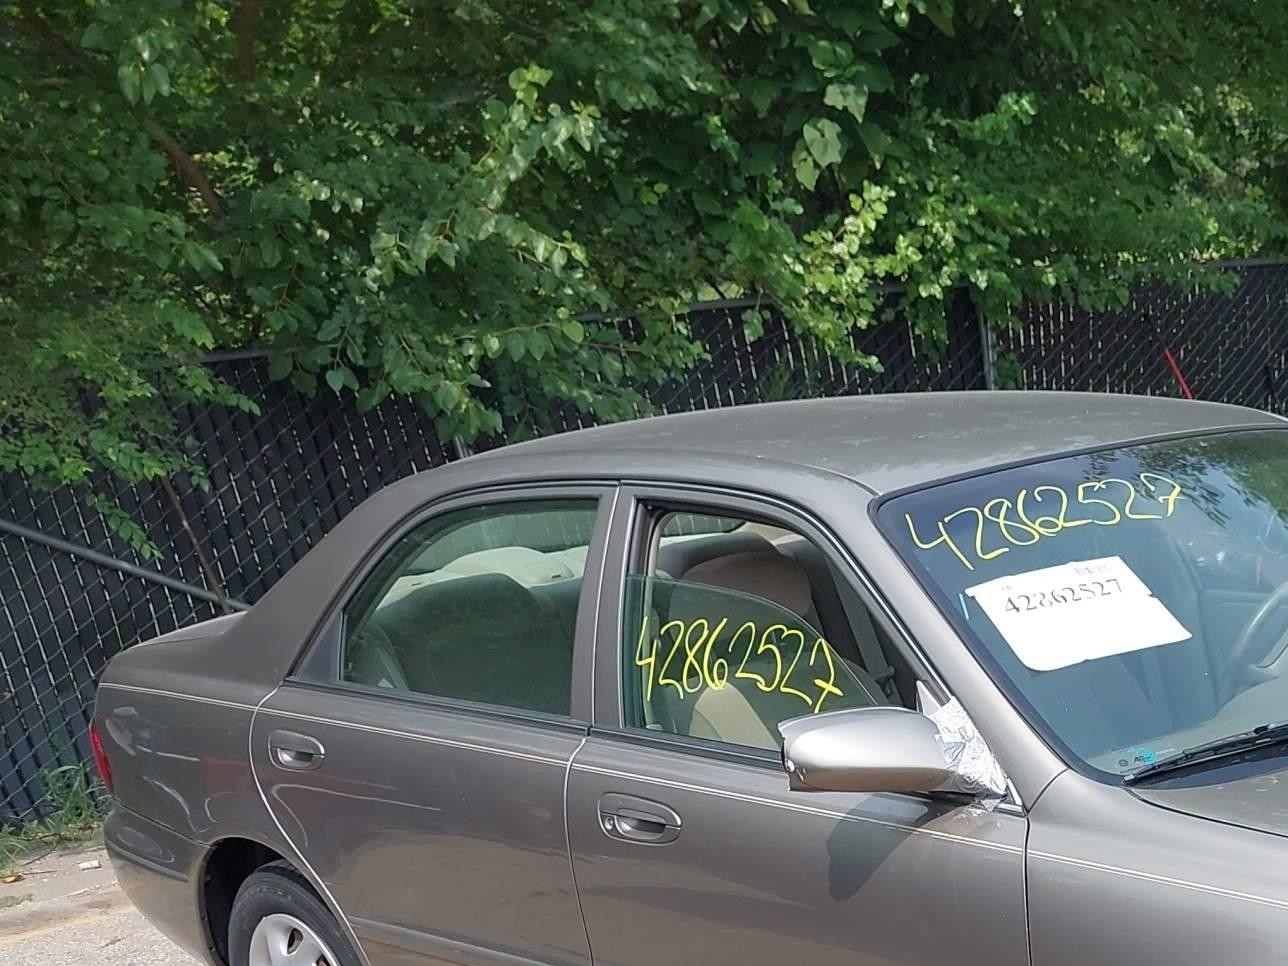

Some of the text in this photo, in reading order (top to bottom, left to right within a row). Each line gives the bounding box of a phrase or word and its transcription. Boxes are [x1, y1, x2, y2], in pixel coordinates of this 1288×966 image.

[904, 473, 1186, 571] 42862527
[1004, 578, 1123, 613] 42862527
[635, 615, 844, 714] 42862527
